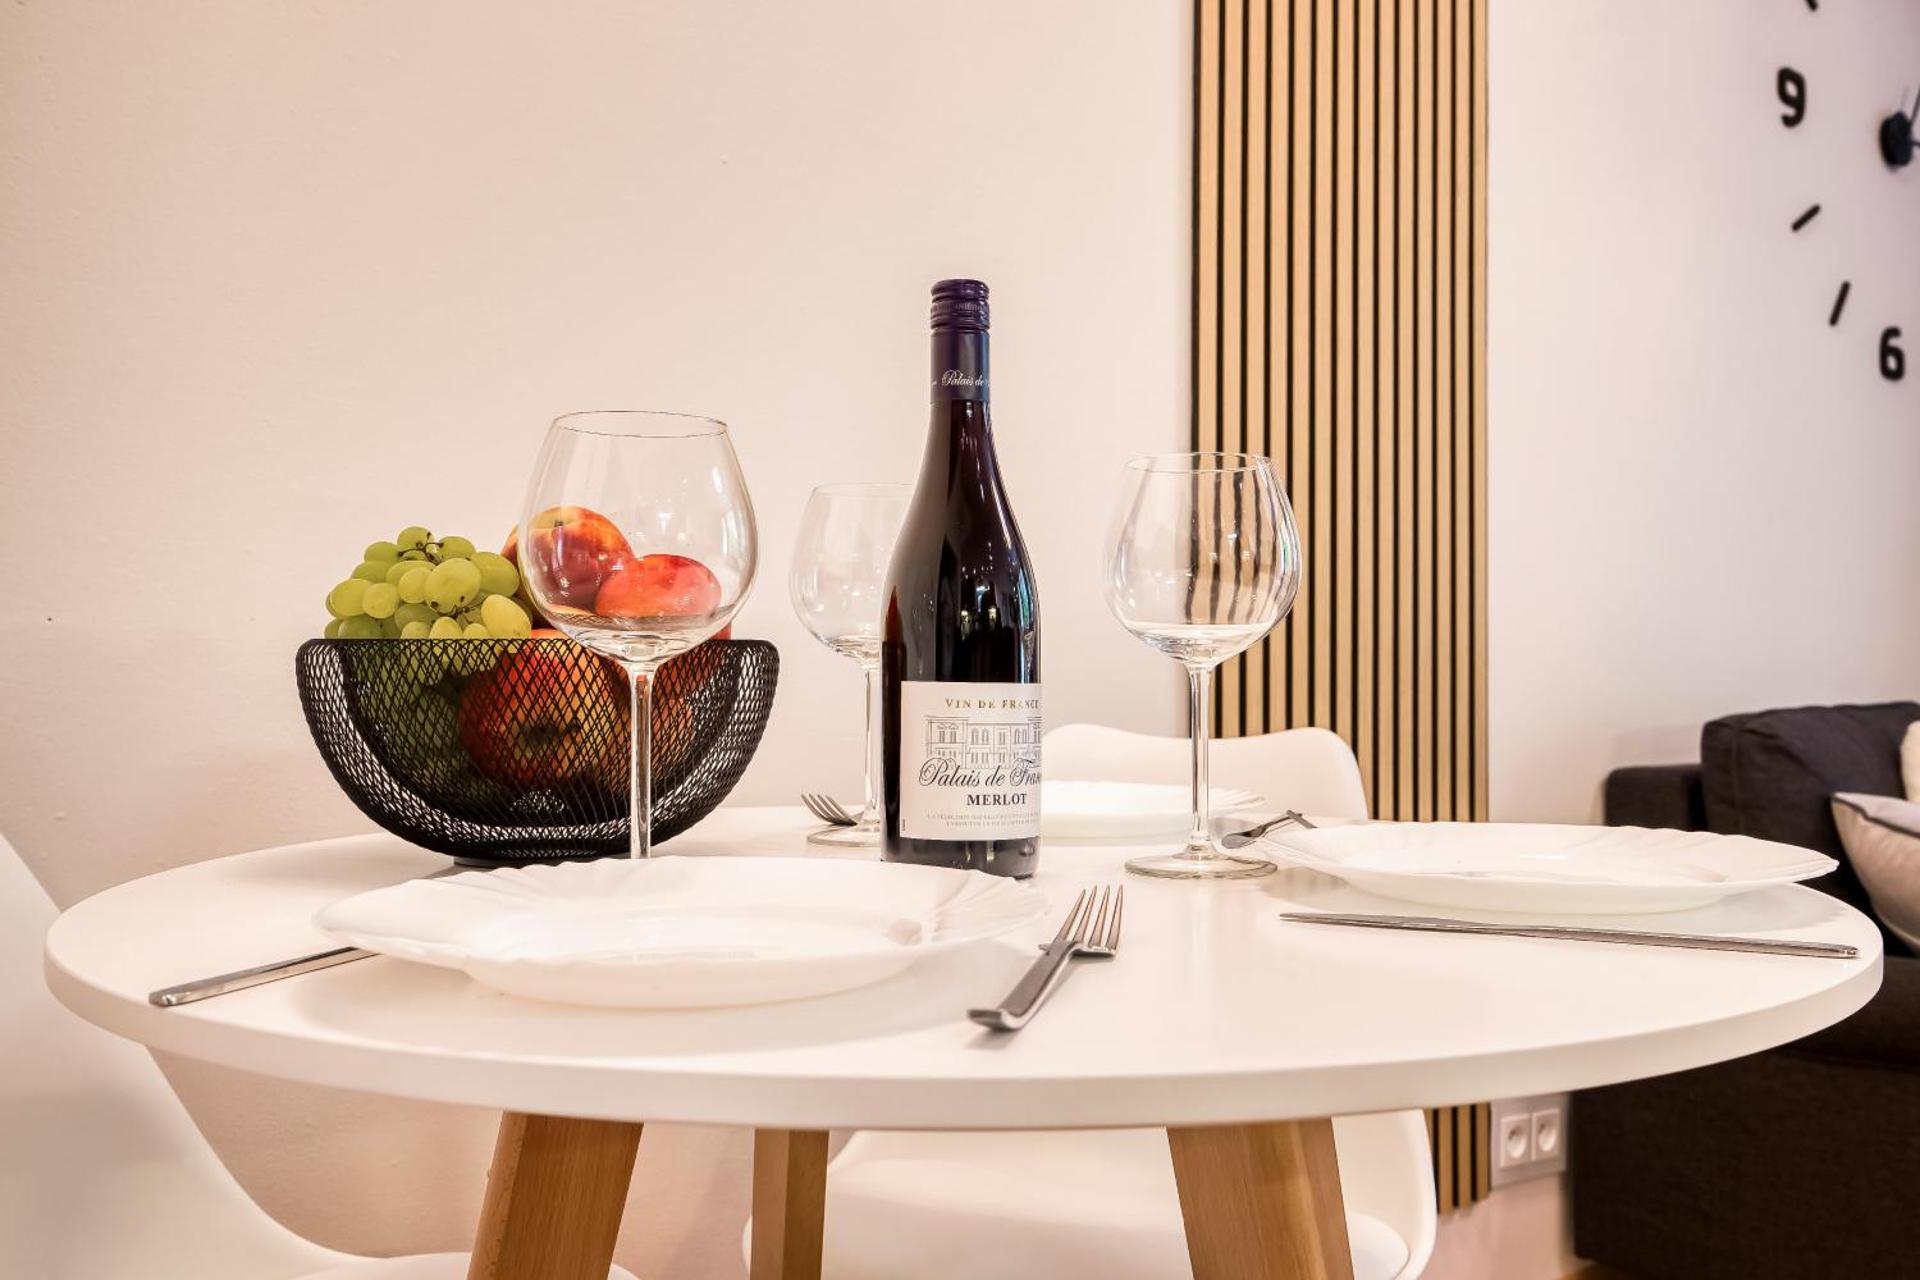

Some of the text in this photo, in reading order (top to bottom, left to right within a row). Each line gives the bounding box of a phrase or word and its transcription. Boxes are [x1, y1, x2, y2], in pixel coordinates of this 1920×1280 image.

[1777, 66, 1807, 128] 9
[1879, 326, 1906, 382] 6
[942, 369, 973, 386] Palais
[975, 374, 984, 386] de
[945, 698, 1040, 709] VIN DE FRANCE
[919, 757, 980, 787] Palais
[985, 765, 1006, 787] de
[967, 793, 1027, 805] MERLOT
